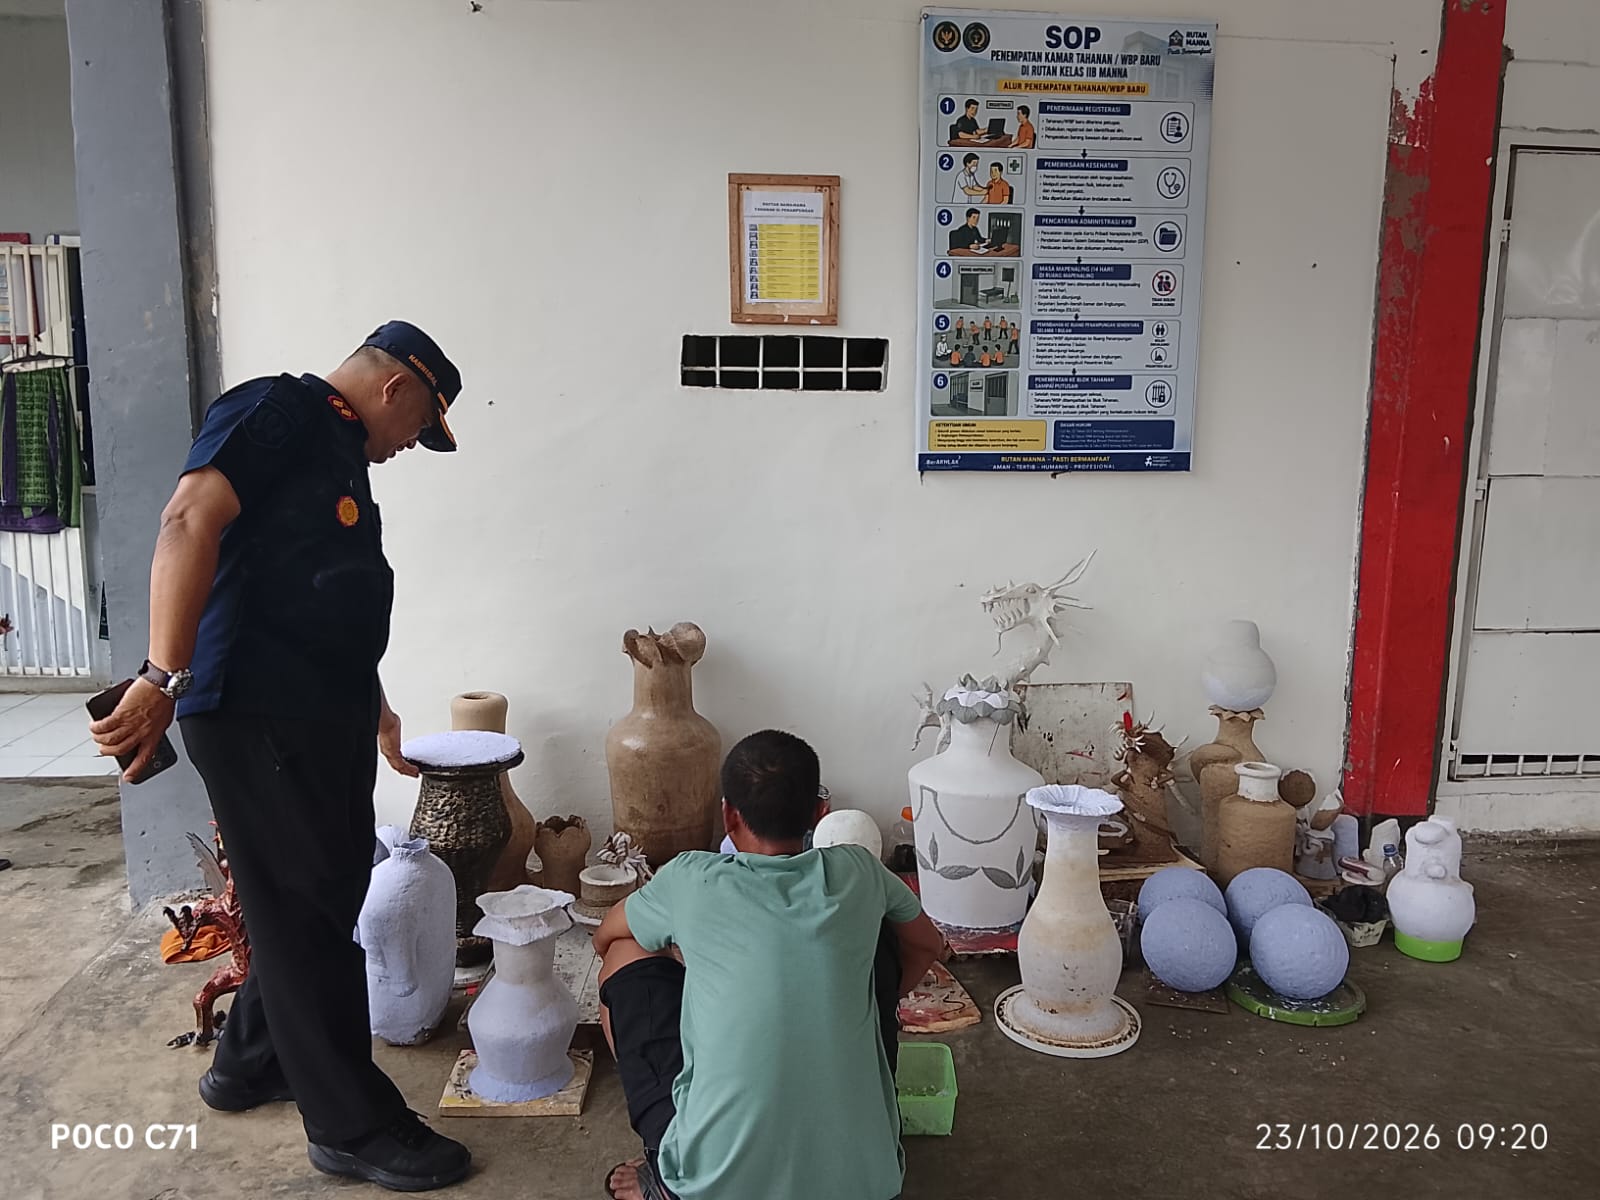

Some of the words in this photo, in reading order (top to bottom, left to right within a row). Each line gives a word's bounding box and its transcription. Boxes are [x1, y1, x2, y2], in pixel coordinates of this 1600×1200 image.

[1046, 25, 1101, 50] SOP
[990, 50, 1042, 63] PENEMPATAN
[1044, 52, 1073, 64] KAMAR
[1076, 53, 1113, 64] TAHANAN
[1115, 54, 1119, 65] /
[1121, 54, 1138, 65] WBP
[1140, 55, 1160, 66] BARU
[1021, 66, 1029, 76] DI
[1031, 66, 1057, 77] RUTAN
[1060, 66, 1084, 77] KELAS
[1086, 67, 1097, 78] IIB
[1100, 67, 1128, 78] MANNA
[1003, 82, 1021, 90] ALUR
[1024, 82, 1071, 92] PENEMPATAN
[1073, 84, 1124, 93] TAHANAN/WBP
[1127, 85, 1146, 93] BARU
[945, 101, 949, 111] 1
[943, 158, 949, 168] 2
[941, 213, 948, 223] 3
[940, 265, 947, 275] 4
[939, 318, 945, 328] 5
[938, 377, 944, 386] 6
